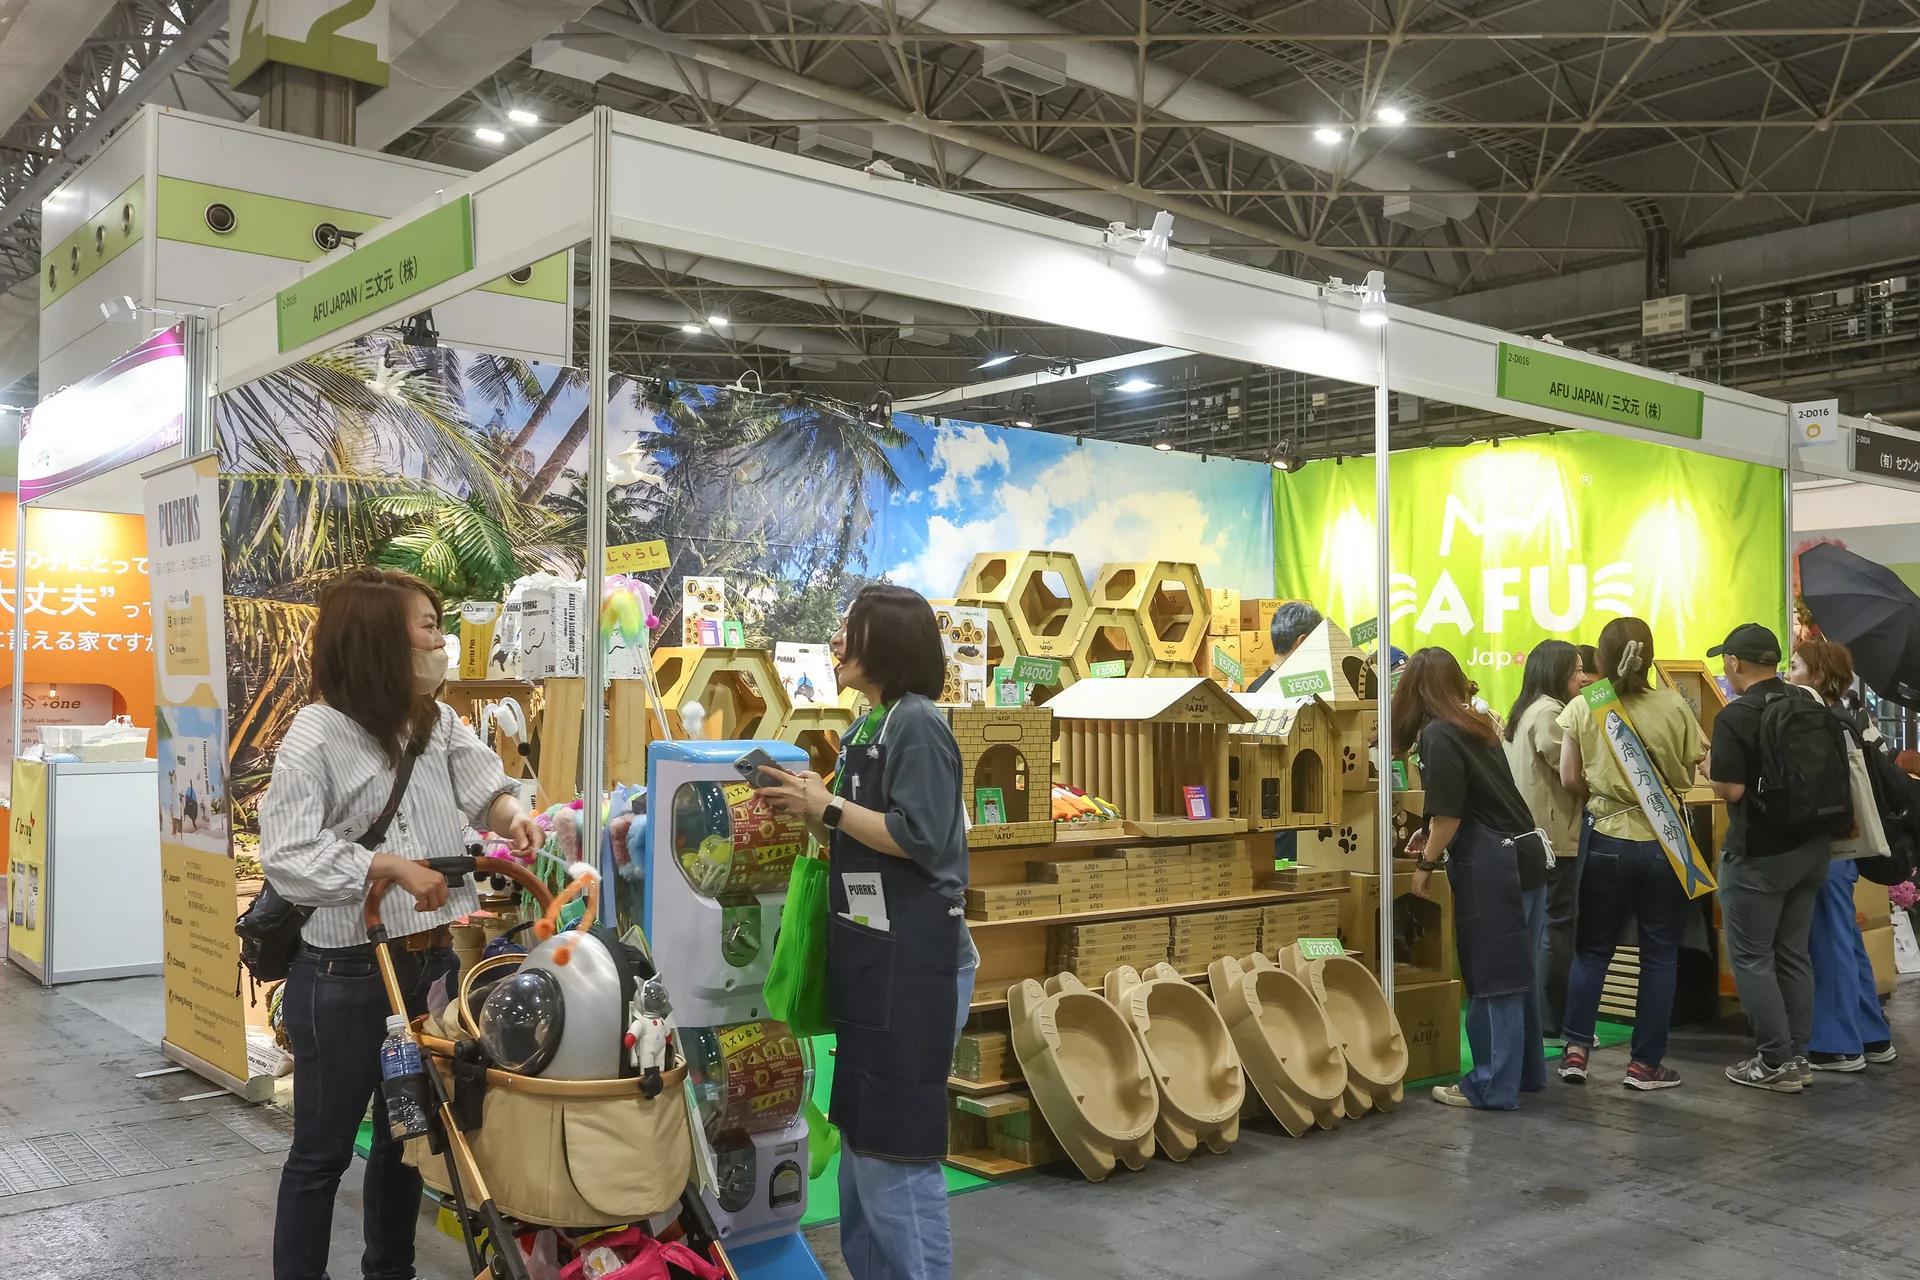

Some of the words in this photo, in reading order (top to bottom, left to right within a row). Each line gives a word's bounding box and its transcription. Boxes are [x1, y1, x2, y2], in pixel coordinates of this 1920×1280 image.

[312, 302, 329, 323] AFU
[330, 286, 358, 315] JAPAN
[1508, 352, 1530, 366] 2-D016
[1550, 381, 1570, 399] AFU
[1572, 386, 1604, 406] JAPAN
[1605, 394, 1610, 408] /
[1798, 408, 1829, 418] 2-D016
[158, 493, 201, 548] PURRKS
[1413, 564, 1588, 637] AFU
[776, 656, 796, 664] PURRKS
[1466, 647, 1525, 670] Jap
[1020, 667, 1053, 680] ¥4000
[1095, 665, 1121, 676] ¥3000
[1287, 678, 1324, 693] ¥5000
[848, 884, 877, 896] PURRKS
[1306, 944, 1339, 955] ¥2000
[1412, 1031, 1433, 1044] AFU
